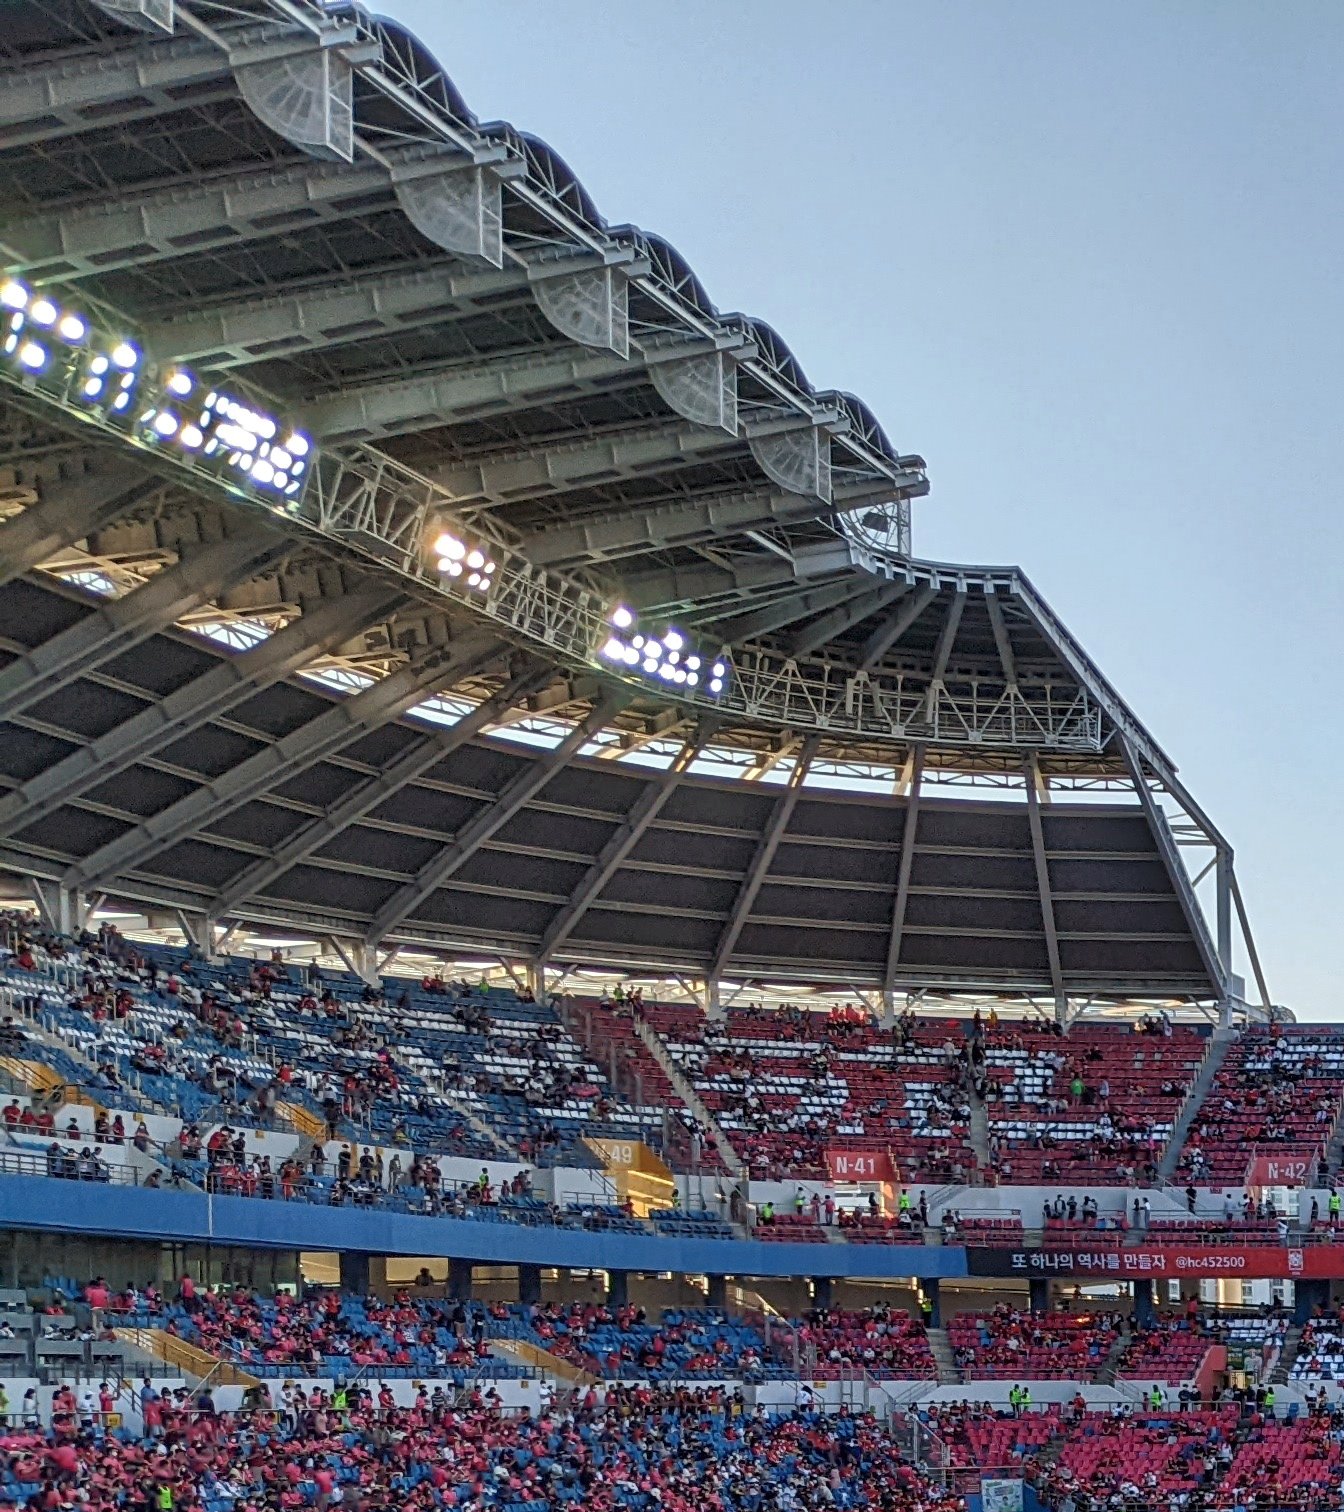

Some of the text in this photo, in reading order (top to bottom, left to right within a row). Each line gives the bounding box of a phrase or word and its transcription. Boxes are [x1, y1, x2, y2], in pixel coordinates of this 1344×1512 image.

[836, 1158, 875, 1175] N-41
[1268, 1162, 1306, 1179] N-42
[1012, 1253, 1245, 1270] 또 하나의 역사를 만들자 @hc452500
